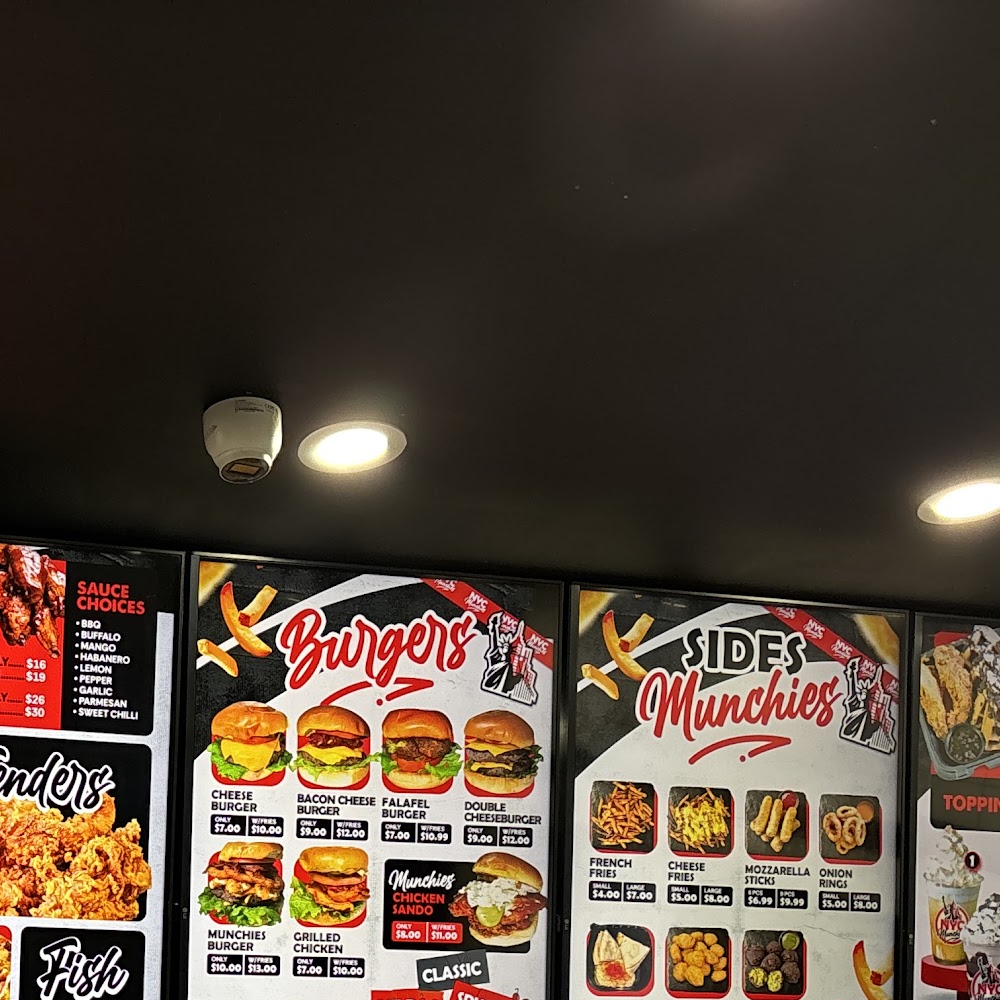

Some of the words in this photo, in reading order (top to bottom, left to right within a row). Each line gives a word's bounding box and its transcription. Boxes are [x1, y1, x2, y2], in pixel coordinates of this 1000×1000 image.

[77, 581, 130, 598] SAUCE
[76, 596, 145, 615] CHOICES
[81, 620, 101, 629] BBQ
[81, 630, 121, 641] BUFFALO
[80, 642, 116, 652] MANGO
[280, 608, 476, 689] Burgers
[684, 628, 806, 674] SIDES
[80, 652, 130, 664] HABANERO
[80, 664, 112, 674] LEMON
[79, 675, 112, 686] PEPPER
[79, 686, 112, 696] GARLIC
[79, 697, 127, 708] PARMESAN
[637, 668, 843, 741] Munchies
[78, 708, 107, 719] SWEET
[110, 709, 138, 720] CHILLI
[211, 790, 253, 800] CHEESE
[297, 794, 336, 805] BACON
[338, 796, 376, 806] CHEESE
[211, 802, 257, 812] BURGER
[297, 804, 340, 816] BURGER
[464, 802, 506, 812] DOUBLE
[464, 813, 542, 825] CHEESEBURGER
[590, 857, 632, 868] FRENCH
[589, 868, 616, 878] FRIES
[745, 865, 810, 877] MOZZARELLA
[819, 868, 853, 879] ONION
[388, 869, 456, 890] Munchies
[745, 875, 775, 886] STICKS
[819, 879, 848, 889] RINGS
[393, 893, 444, 904] CHICKEN
[592, 890, 620, 899] $4.00
[392, 904, 434, 916] SANDO
[208, 929, 266, 941] MUNCHIES
[39, 938, 128, 1000] Fish
[422, 960, 483, 984] CLASSIC
